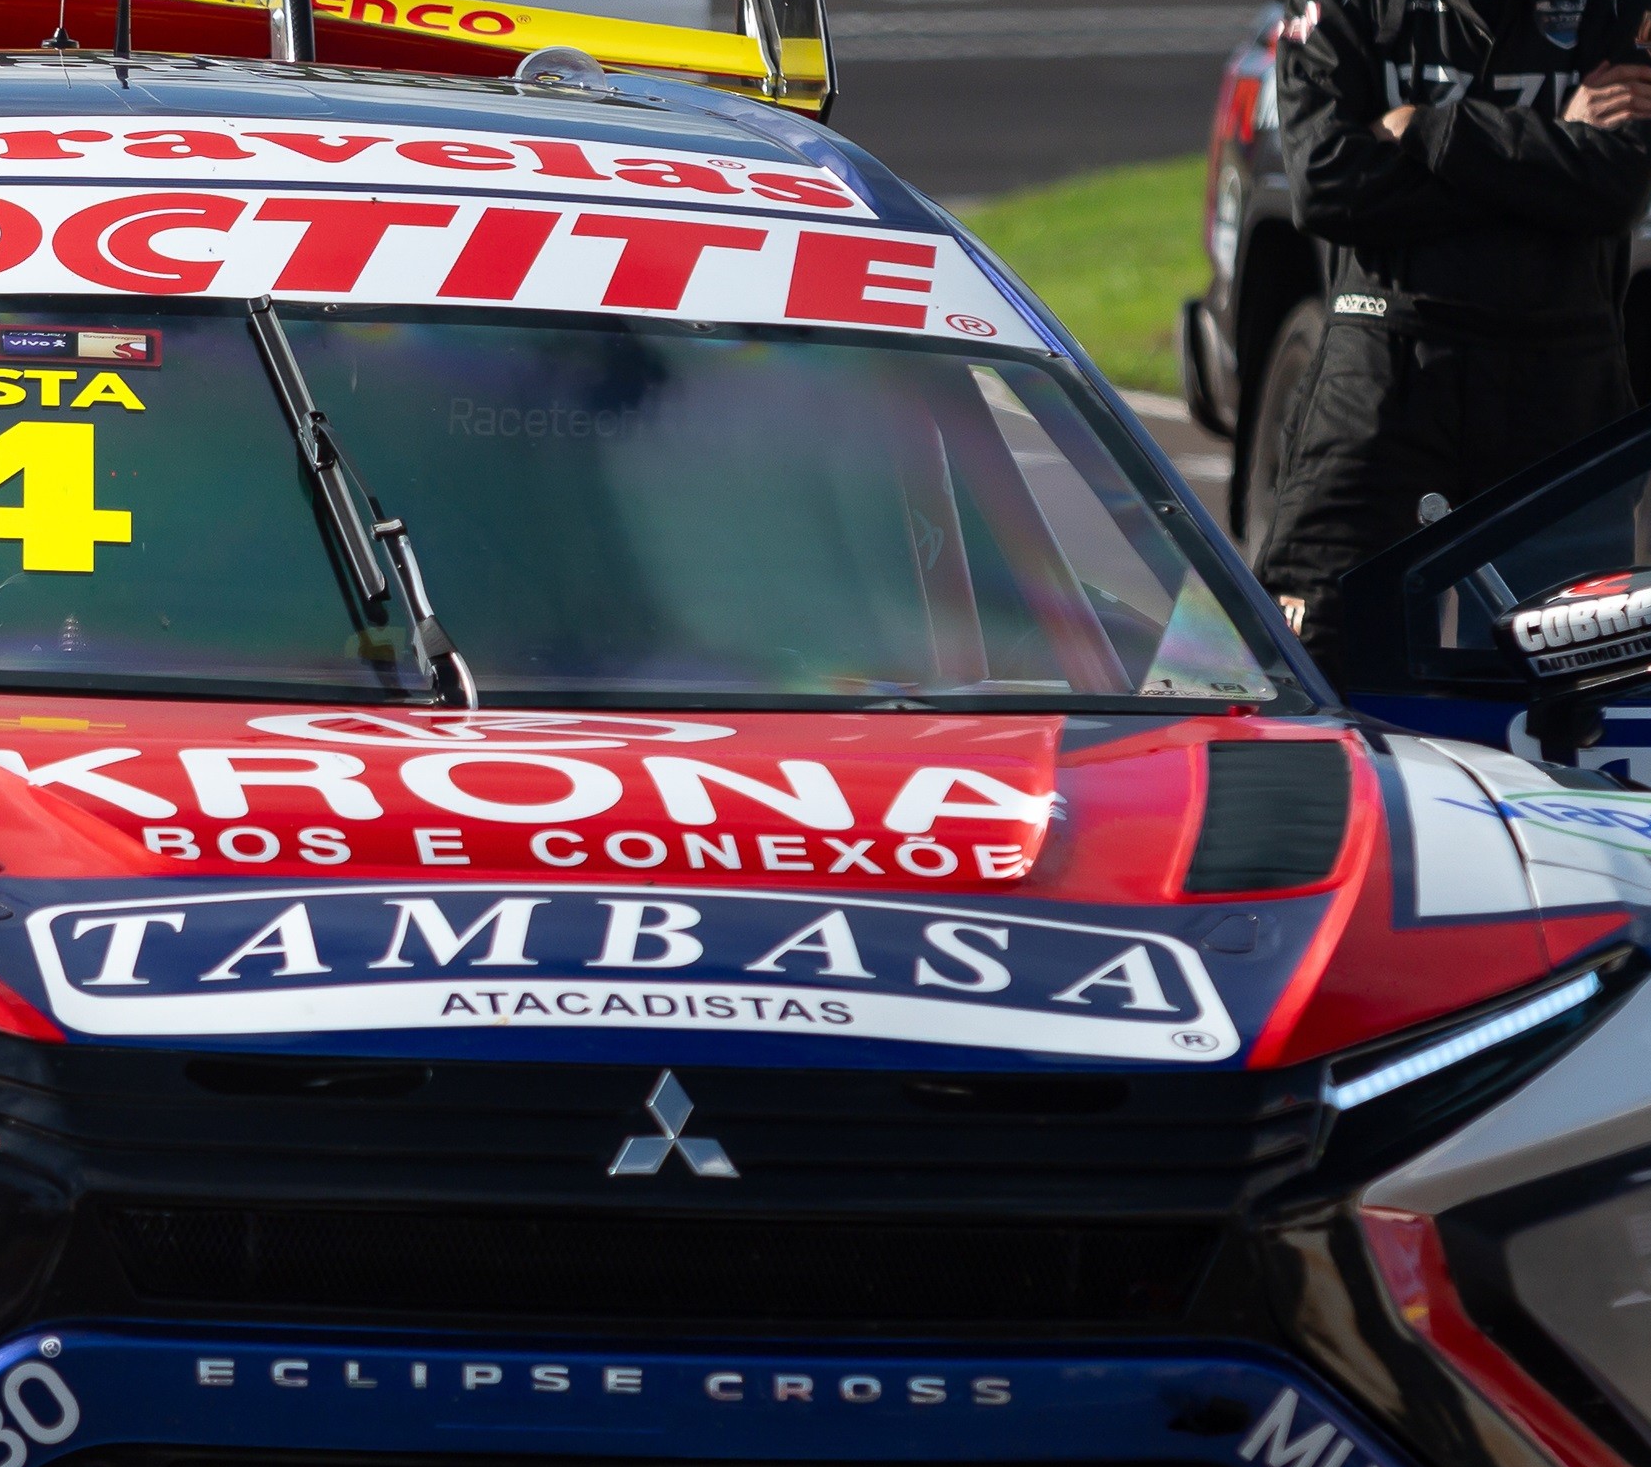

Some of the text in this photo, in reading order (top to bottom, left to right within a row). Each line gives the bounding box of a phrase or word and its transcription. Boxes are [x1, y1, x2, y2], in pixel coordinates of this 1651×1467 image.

[9, 338, 50, 348] vivo
[416, 826, 472, 867] E
[530, 826, 1028, 880] CONEXÕE
[71, 895, 1182, 1014] TAMBASA
[440, 991, 858, 1028] ATACADISTAS
[195, 1357, 1015, 1407] ECLIPSE CROSS
